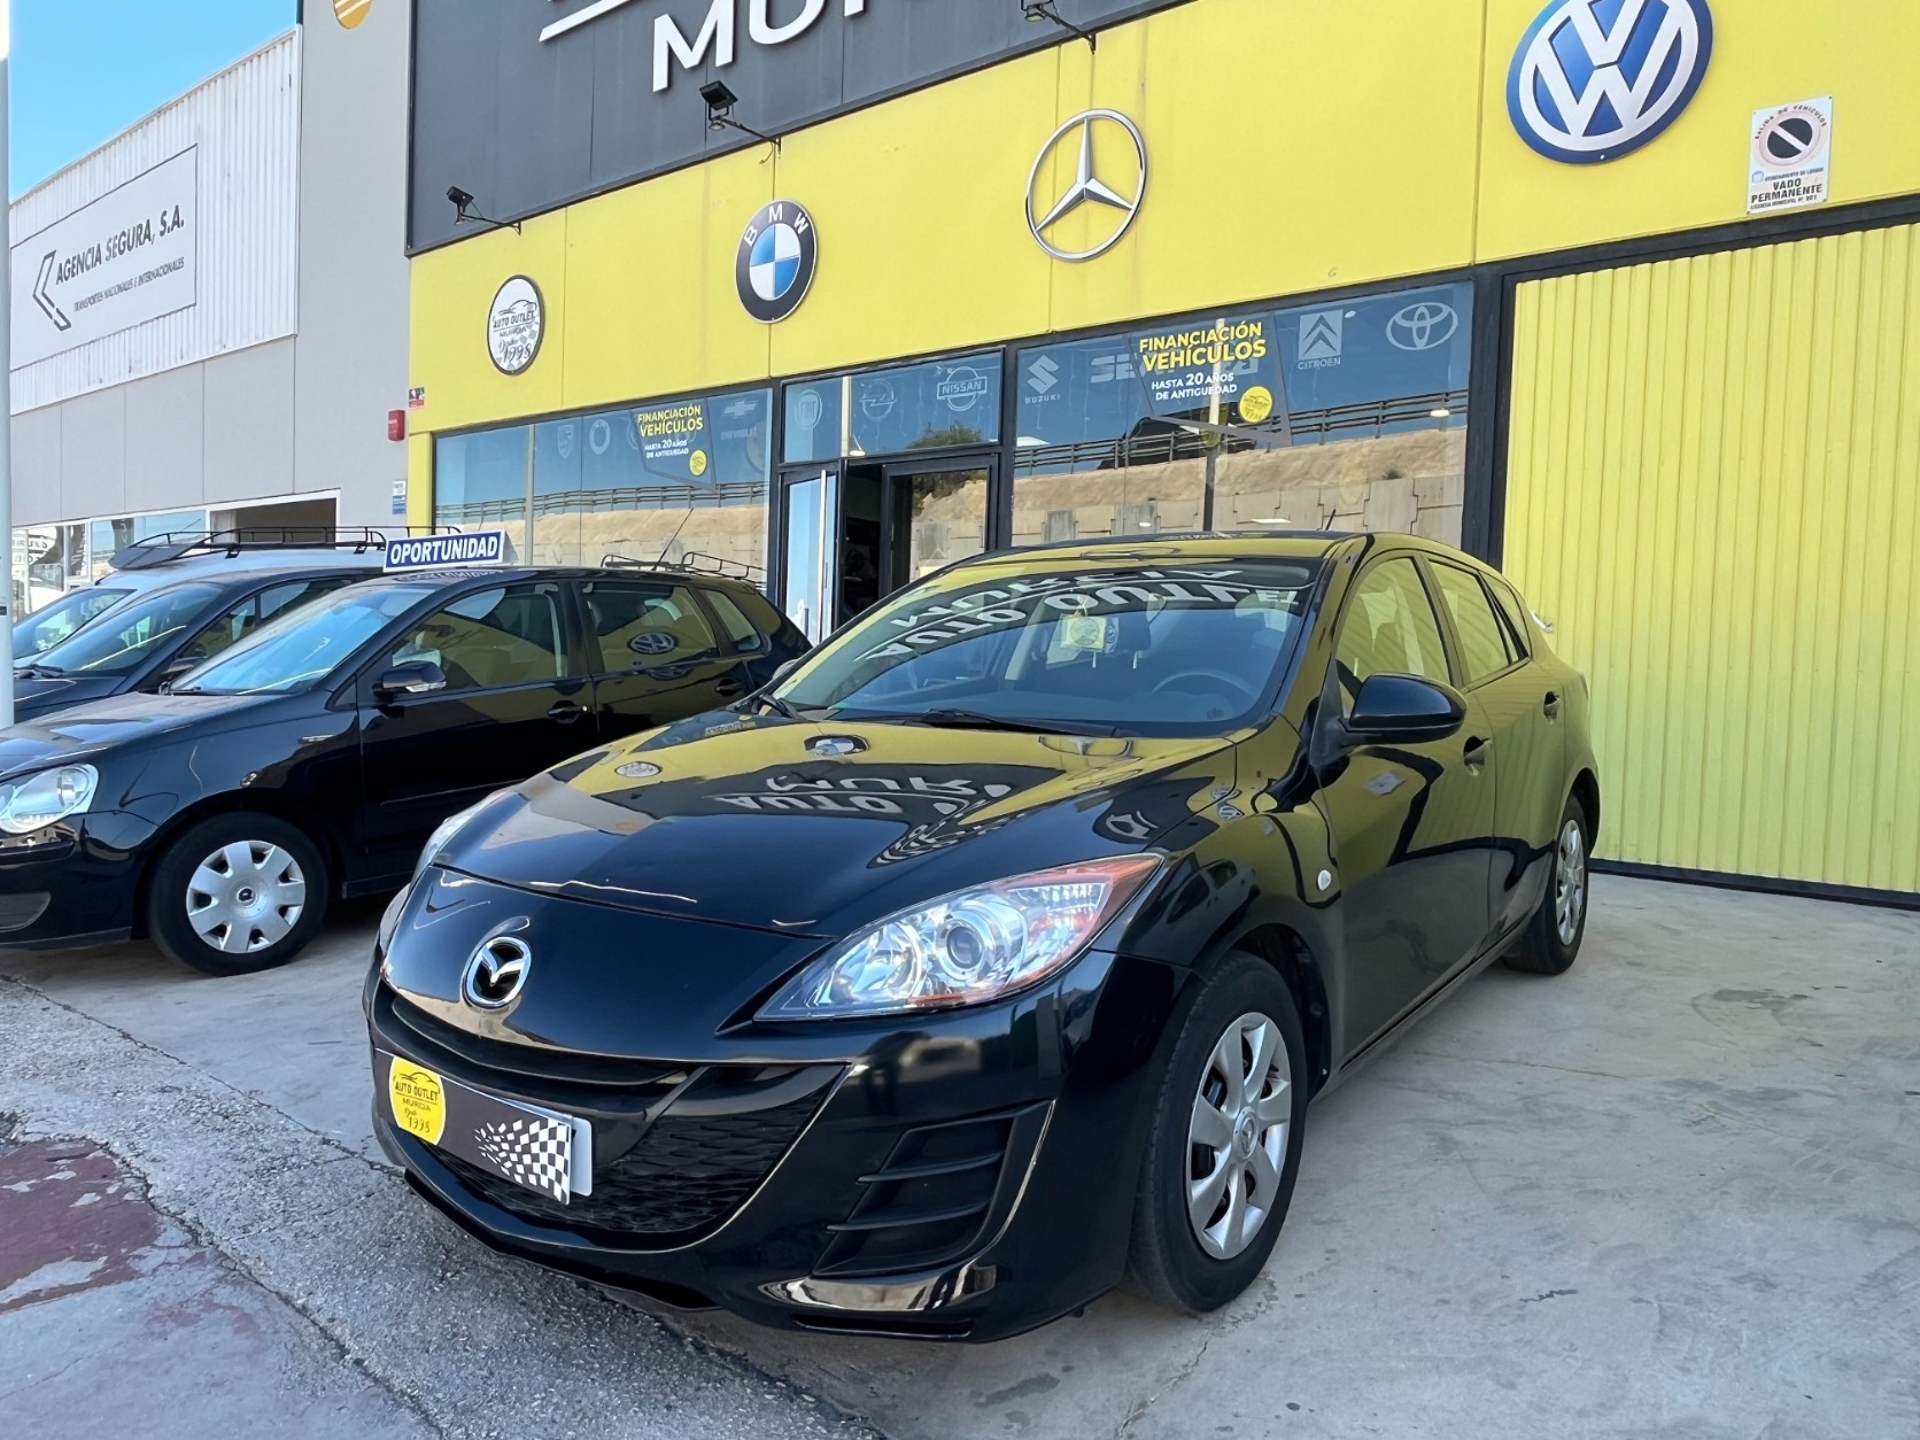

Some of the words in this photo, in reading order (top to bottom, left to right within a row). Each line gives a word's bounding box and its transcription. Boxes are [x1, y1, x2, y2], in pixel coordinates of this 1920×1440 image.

[653, 0, 864, 93] MU
[1751, 184, 1823, 203] PERMANENTE
[1773, 178, 1802, 190] VADO
[744, 203, 809, 247] BMW
[55, 243, 102, 285] AGENCIA
[105, 219, 155, 262] SEGURA,
[159, 204, 185, 237] S.A.
[138, 256, 185, 287] INTERNACIONALES
[493, 316, 509, 328] AUTO
[510, 310, 536, 324] OUTLET
[1139, 320, 1262, 353] FINANCIACIÓN
[503, 342, 533, 363] 1998
[1142, 338, 1267, 372] VEHÍCULOS
[941, 379, 982, 394] NISSAN
[1151, 377, 1184, 391] HASTA
[1185, 372, 1204, 386] 20
[1204, 372, 1234, 385] AÑOS
[1024, 394, 1060, 404] SUZUKI
[1155, 391, 1169, 401] DE
[1170, 384, 1238, 400] ANTIGUEDAD
[637, 404, 702, 423] FINANCIACIÓN
[640, 417, 704, 437] VEHÍCULOS
[644, 443, 662, 451] HASTA
[662, 439, 672, 448] 20
[672, 439, 688, 447] AÑOS
[646, 451, 654, 459] DE
[390, 536, 498, 565] OPORTUNIDAD
[395, 1081, 412, 1094] AUTO
[414, 1086, 438, 1101] OUTLET
